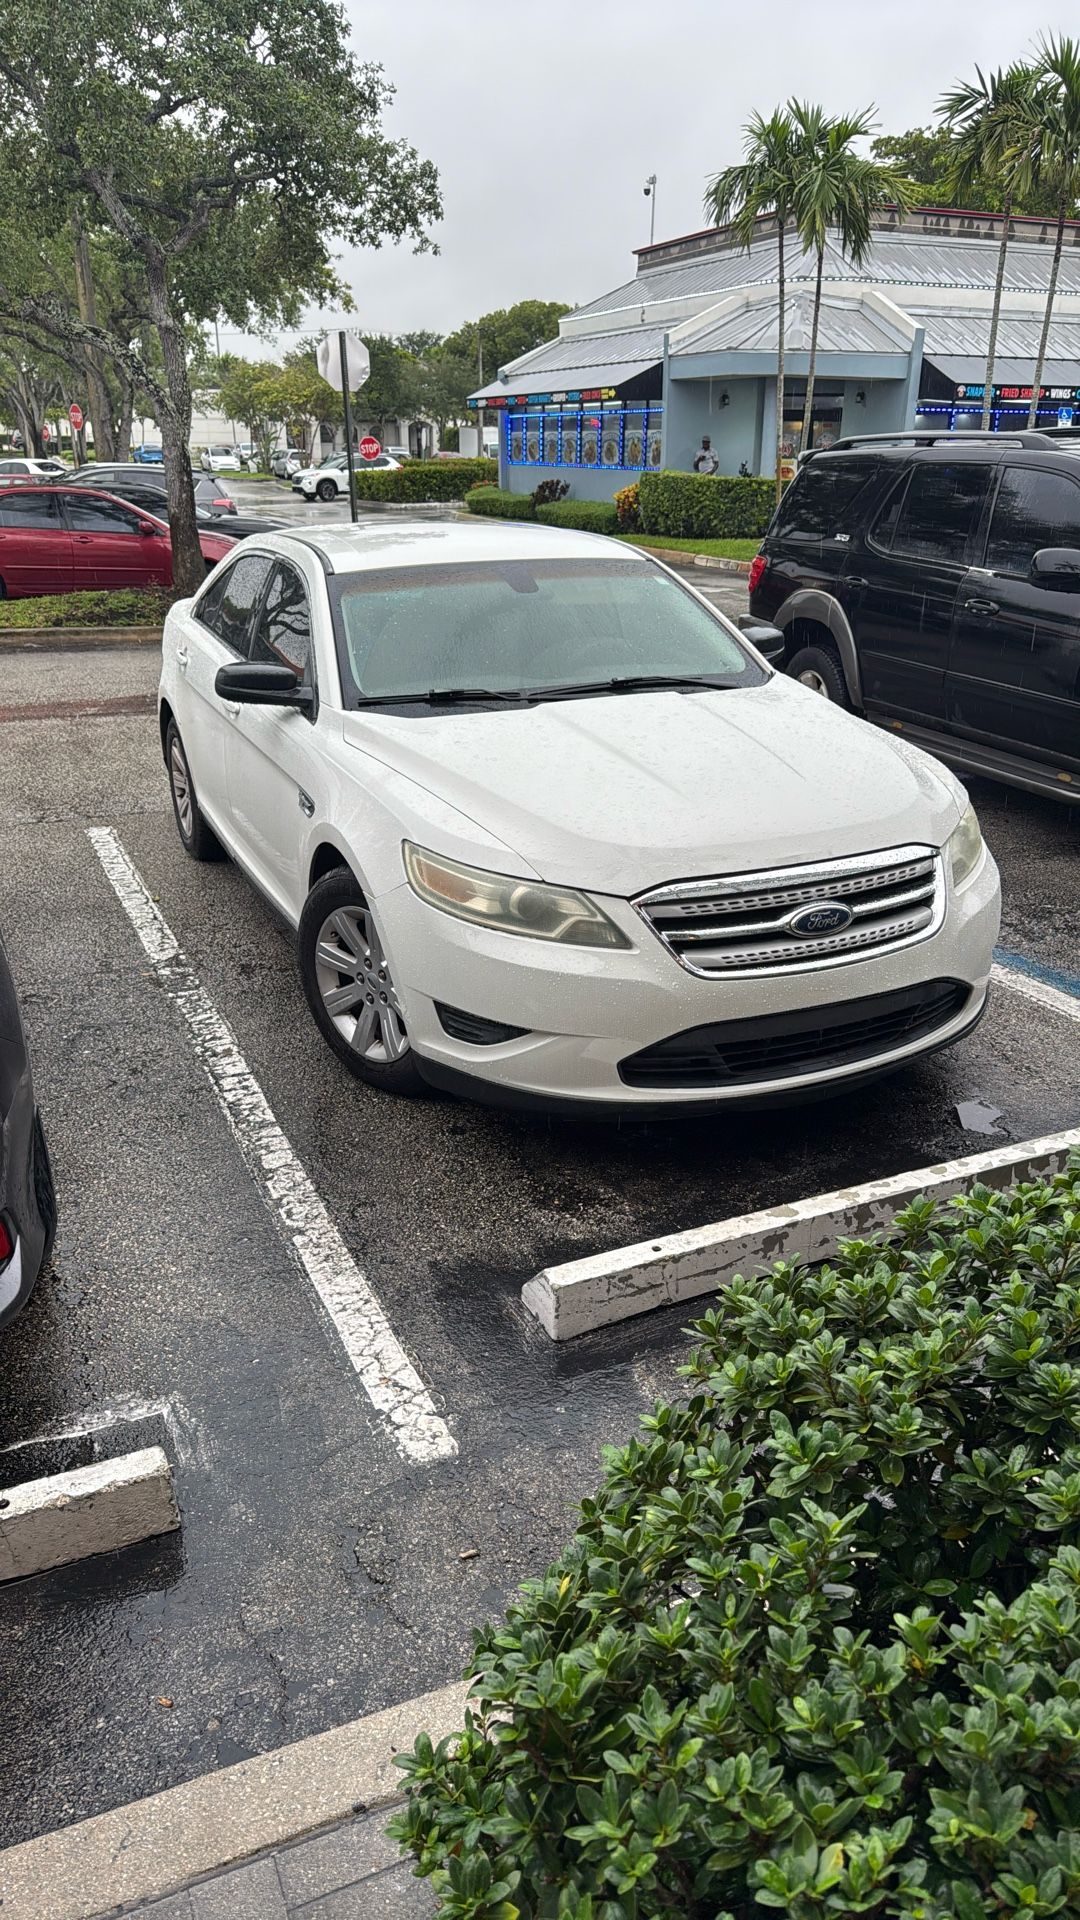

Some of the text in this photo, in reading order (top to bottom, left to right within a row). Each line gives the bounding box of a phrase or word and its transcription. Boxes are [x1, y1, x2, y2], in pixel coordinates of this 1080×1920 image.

[966, 387, 995, 398] SNAPR
[1001, 387, 1020, 398] FRIED
[1050, 389, 1071, 399] WINGS
[361, 444, 377, 454] STOP
[807, 910, 840, 930] Ford
